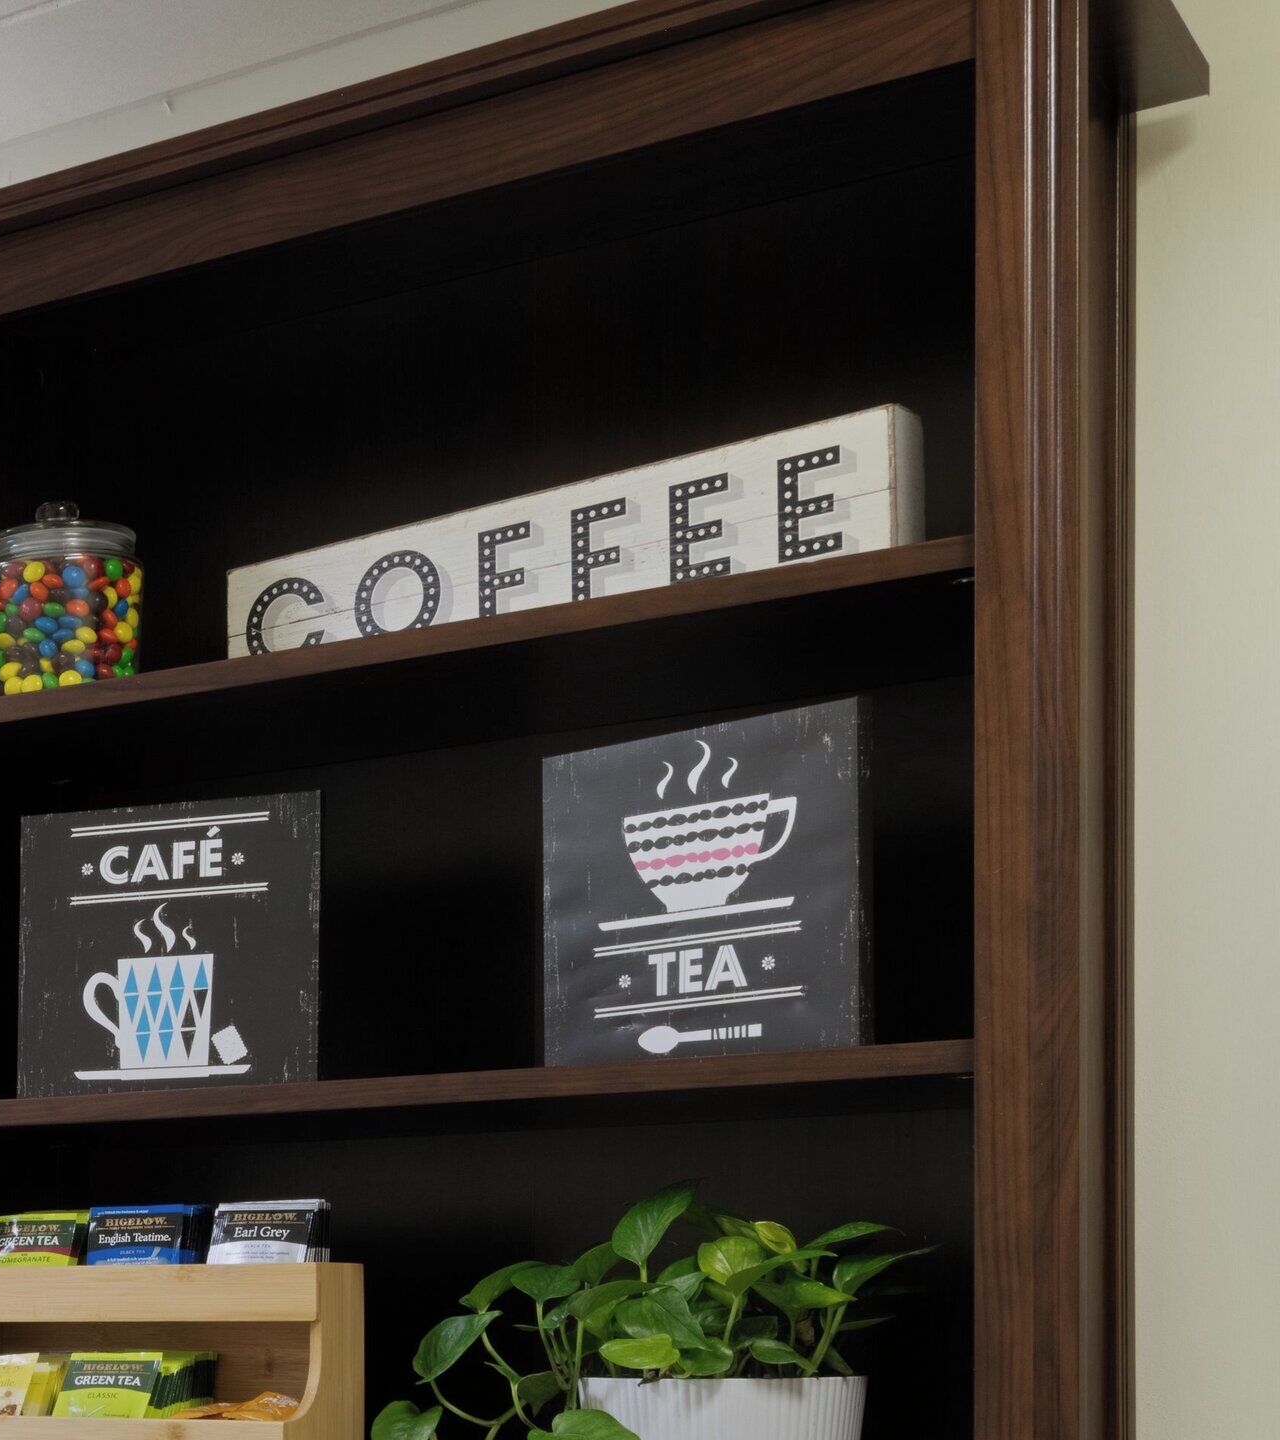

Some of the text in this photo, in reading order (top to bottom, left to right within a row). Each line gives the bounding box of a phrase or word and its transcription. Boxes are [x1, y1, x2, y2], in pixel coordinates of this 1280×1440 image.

[246, 446, 843, 655] COFFEE
[99, 825, 223, 885] CAFÉ
[648, 944, 748, 996] TEA
[104, 1216, 167, 1228] BIGELOW
[232, 1212, 297, 1222] BIGELOW
[98, 1232, 132, 1246] English
[233, 1225, 291, 1240] Earl Grey
[38, 1234, 60, 1246] TEA
[74, 1375, 142, 1387] GREEN TEA
[86, 1391, 119, 1400] CLASSIC
